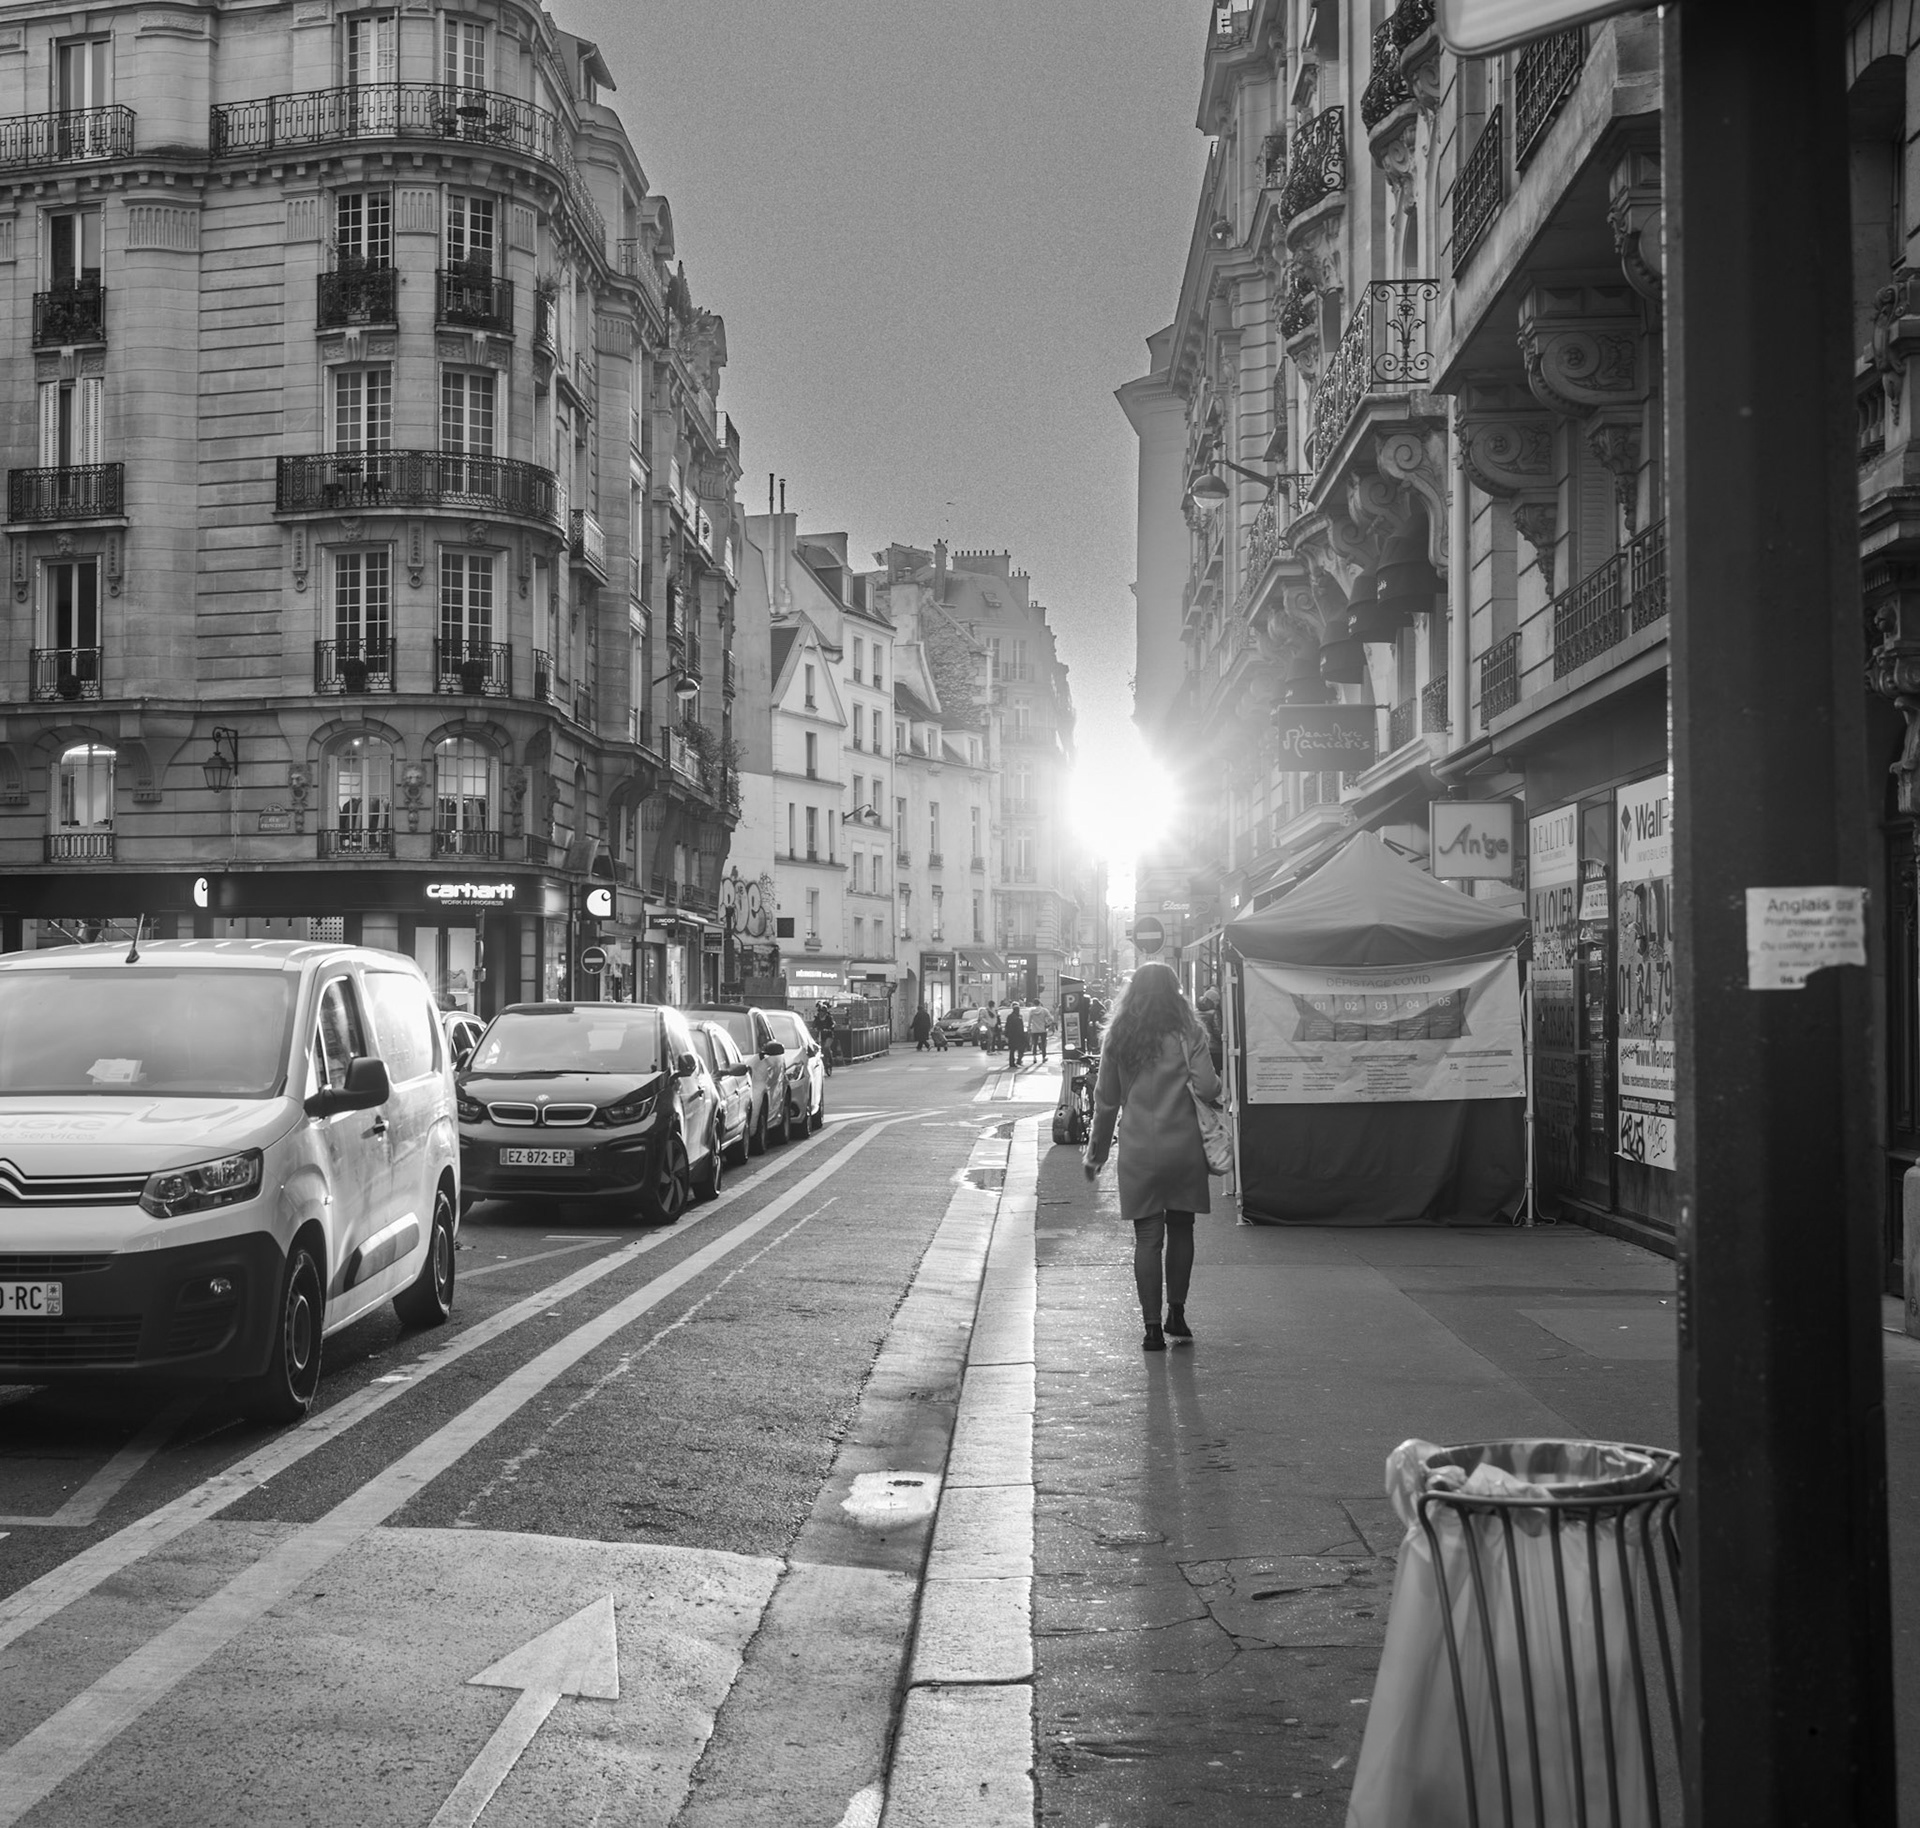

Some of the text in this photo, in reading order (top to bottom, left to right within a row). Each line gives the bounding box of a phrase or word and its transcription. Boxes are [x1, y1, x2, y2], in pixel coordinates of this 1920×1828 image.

[426, 882, 516, 899] carhartt
[1767, 898, 1831, 915] Anglais
[1393, 974, 1431, 986] COVID
[1618, 963, 1631, 1015] 01
[1656, 960, 1673, 1016] 79
[1066, 995, 1076, 1008] P
[1314, 1001, 1327, 1011] 01
[1344, 1001, 1358, 1011] 02
[1375, 1001, 1388, 1011] 03
[1406, 1000, 1420, 1010] 04
[1438, 997, 1451, 1006] 05
[508, 1150, 567, 1163] EZ-872-EP
[47, 1300, 60, 1312] 75
